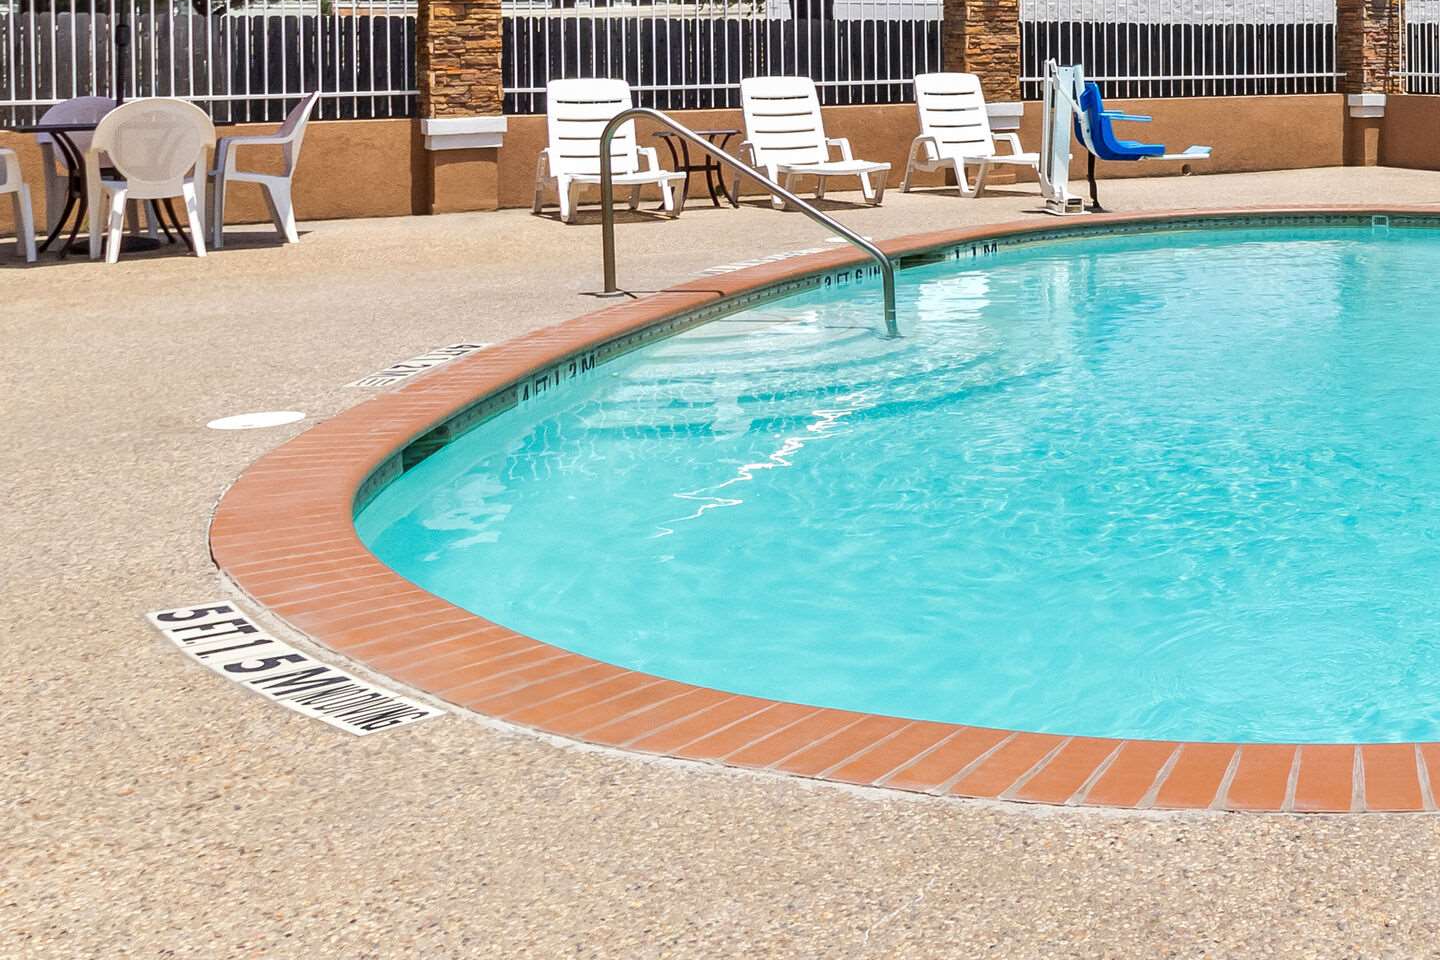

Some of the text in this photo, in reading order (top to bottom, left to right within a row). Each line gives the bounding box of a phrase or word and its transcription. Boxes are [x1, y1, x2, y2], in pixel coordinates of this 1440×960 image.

[581, 354, 595, 373] M
[156, 605, 235, 622] 5
[250, 666, 353, 697] M
[311, 692, 432, 732] DIVING
